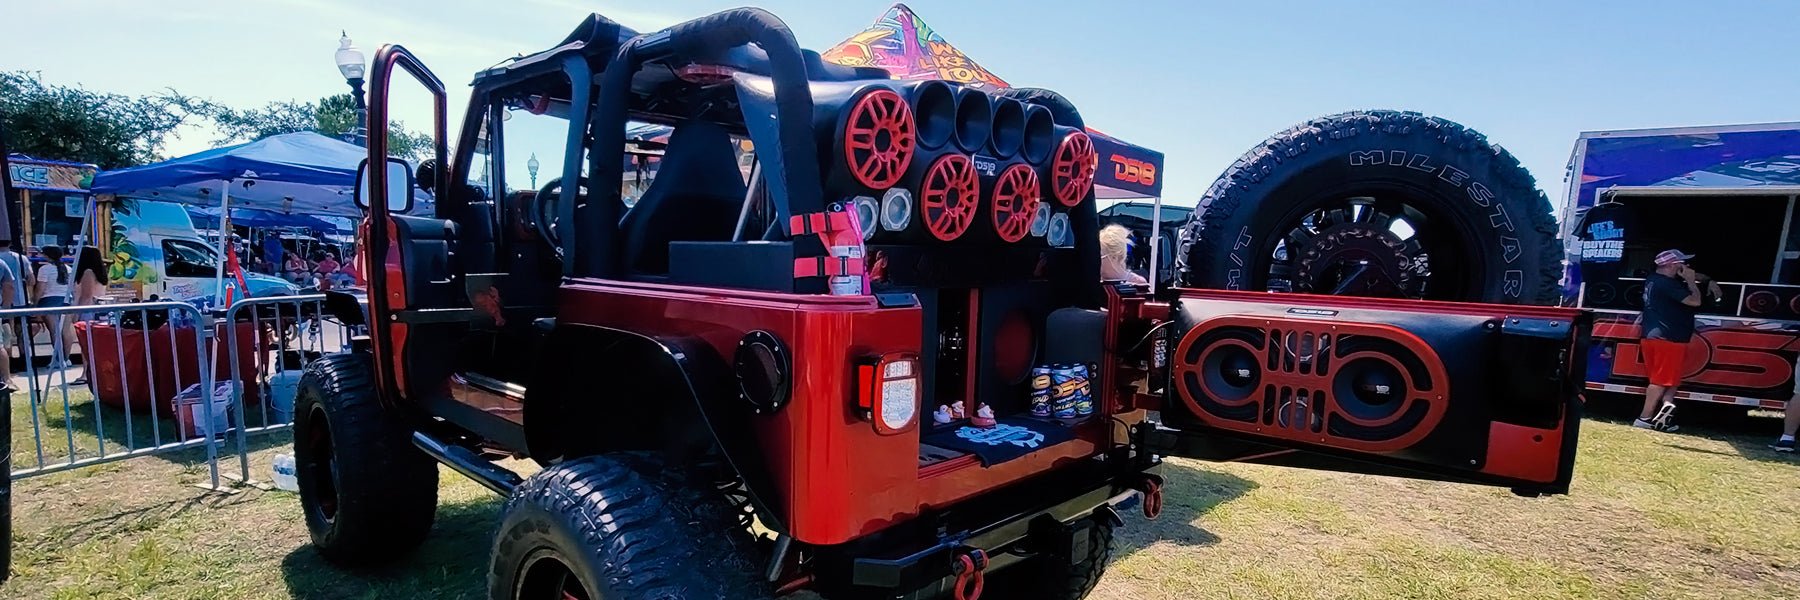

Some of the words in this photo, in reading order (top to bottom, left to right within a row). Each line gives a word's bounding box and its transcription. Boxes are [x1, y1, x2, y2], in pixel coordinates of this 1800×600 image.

[920, 55, 969, 70] LIKE
[10, 165, 49, 185] ICE
[1110, 154, 1156, 186] DS18
[1349, 150, 1523, 298] MILESTAR
[1605, 241, 1625, 249] THE
[1591, 322, 1800, 389] DS
